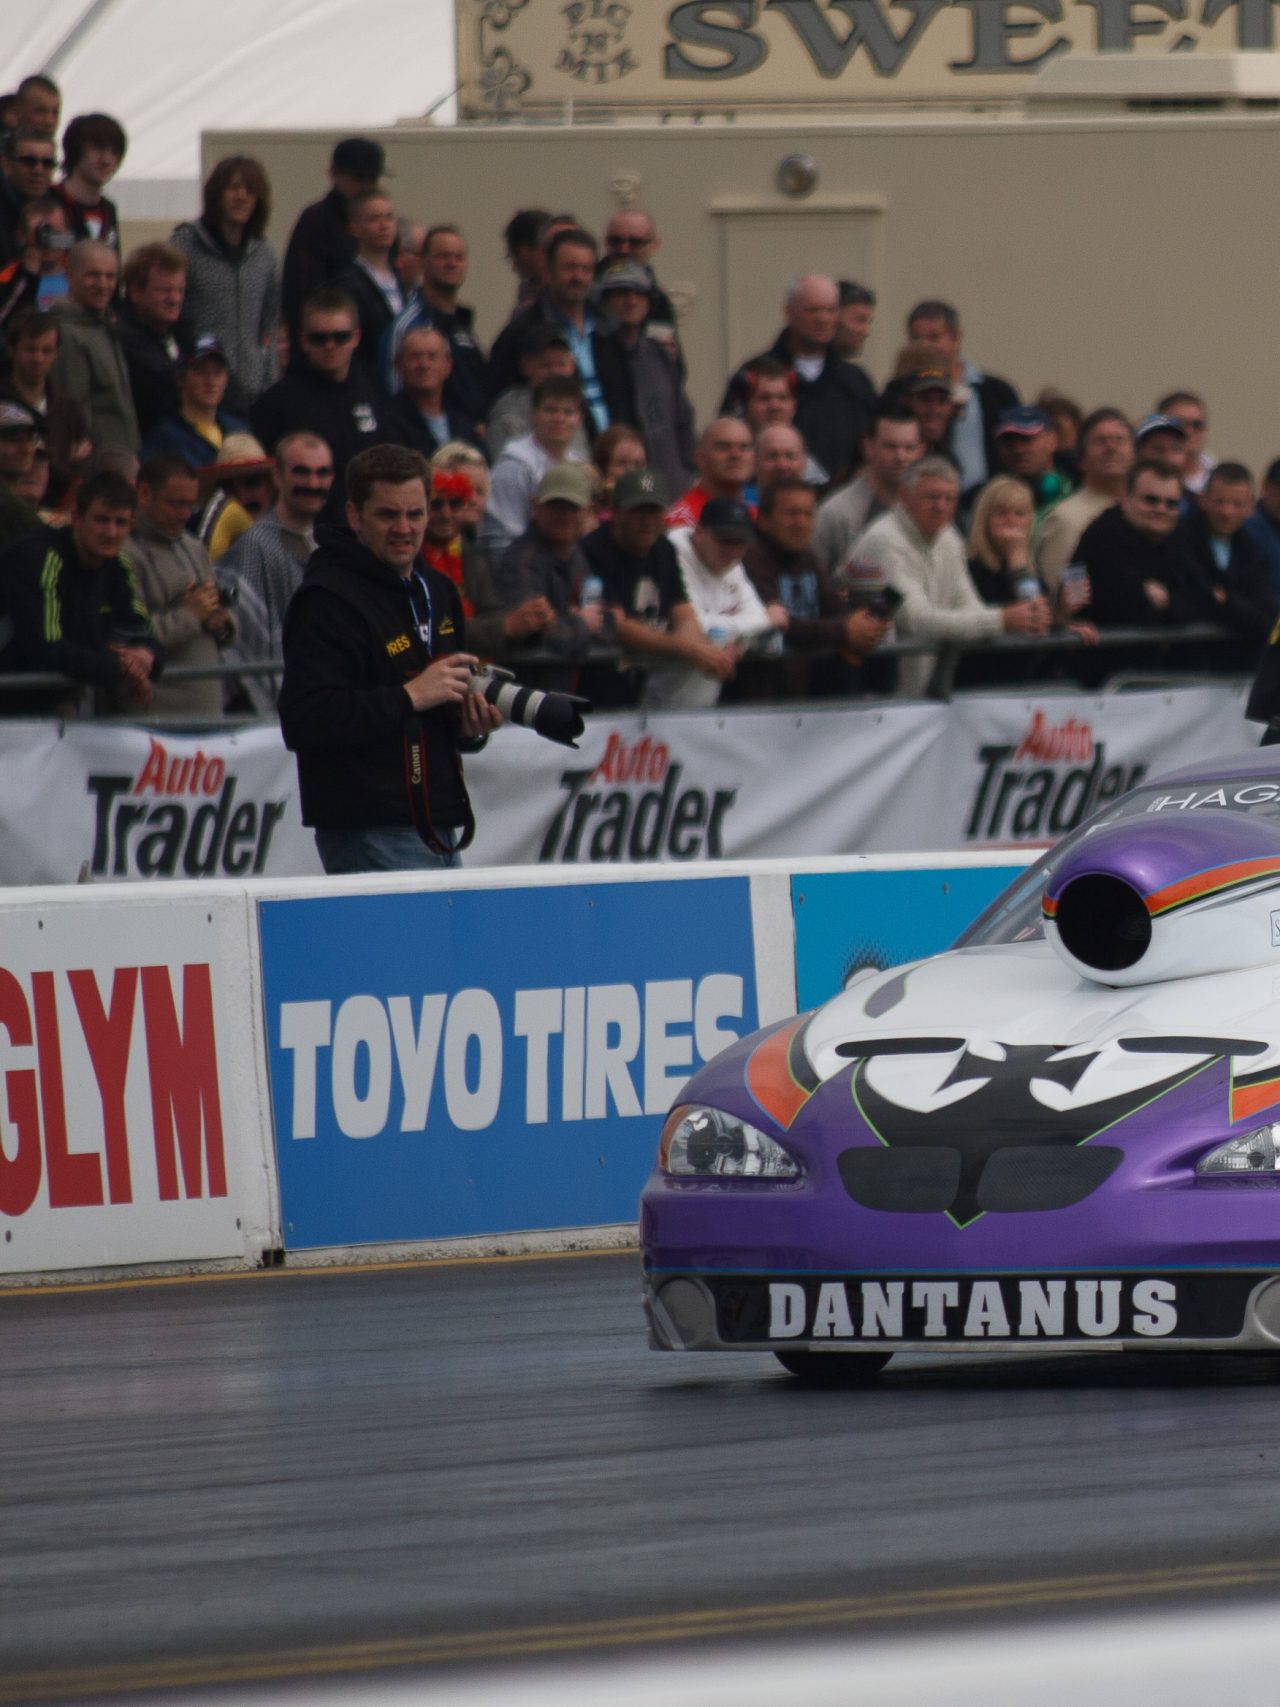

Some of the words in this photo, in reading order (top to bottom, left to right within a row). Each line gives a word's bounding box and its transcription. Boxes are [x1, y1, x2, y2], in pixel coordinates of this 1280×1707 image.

[133, 735, 226, 797] Auto
[587, 730, 669, 785] Auto
[1013, 709, 1093, 763] Auto
[87, 775, 287, 878] Trader
[539, 763, 740, 863] Trader
[280, 988, 503, 1140] TOYO
[514, 972, 743, 1125] TIRES
[768, 1280, 1179, 1339] DANTANUS
